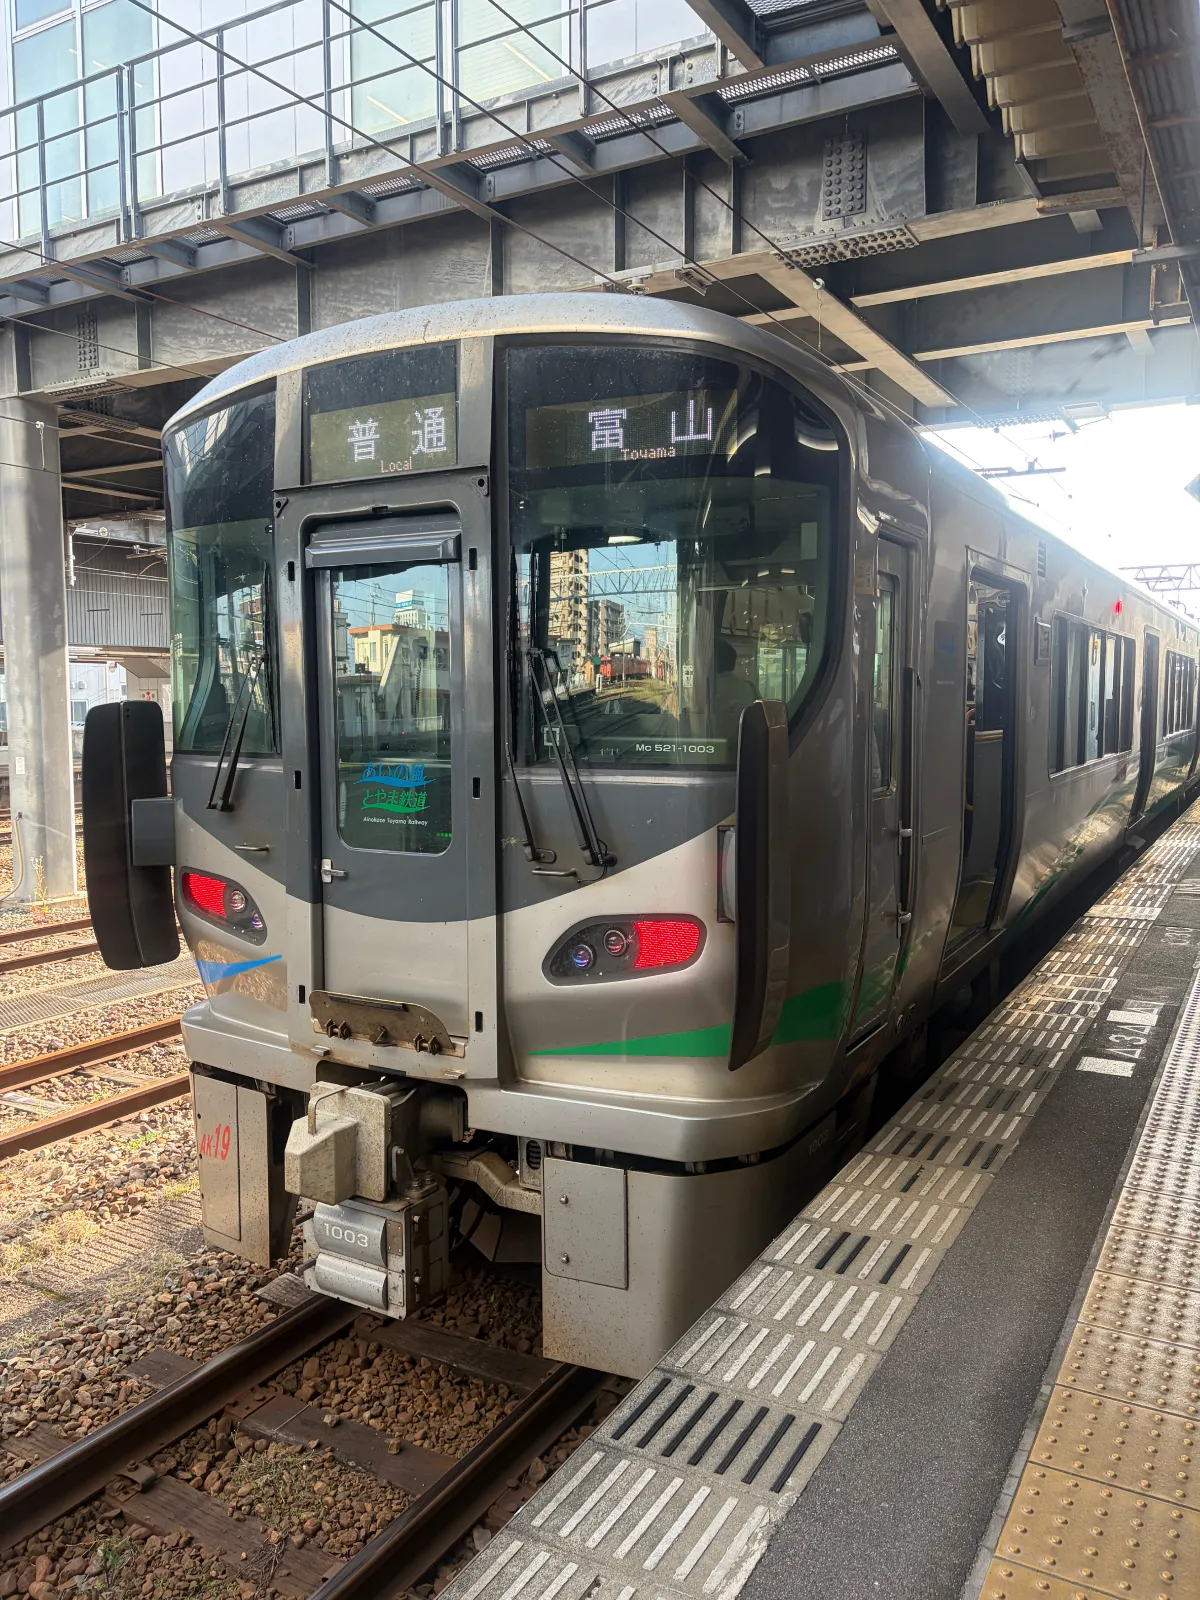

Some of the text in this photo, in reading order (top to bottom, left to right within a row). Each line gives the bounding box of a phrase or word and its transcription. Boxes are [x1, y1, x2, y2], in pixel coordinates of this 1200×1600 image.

[347, 406, 447, 463] 普通
[588, 399, 713, 451] 富山
[620, 446, 676, 462] Toyama
[380, 456, 413, 474] Local
[635, 743, 715, 754] Mc 521-1003
[361, 762, 427, 783] あいの風
[362, 788, 428, 809] とやま鉄道
[387, 817, 407, 825] Toyama
[407, 818, 429, 827] Railway
[323, 1222, 369, 1248] 1003
